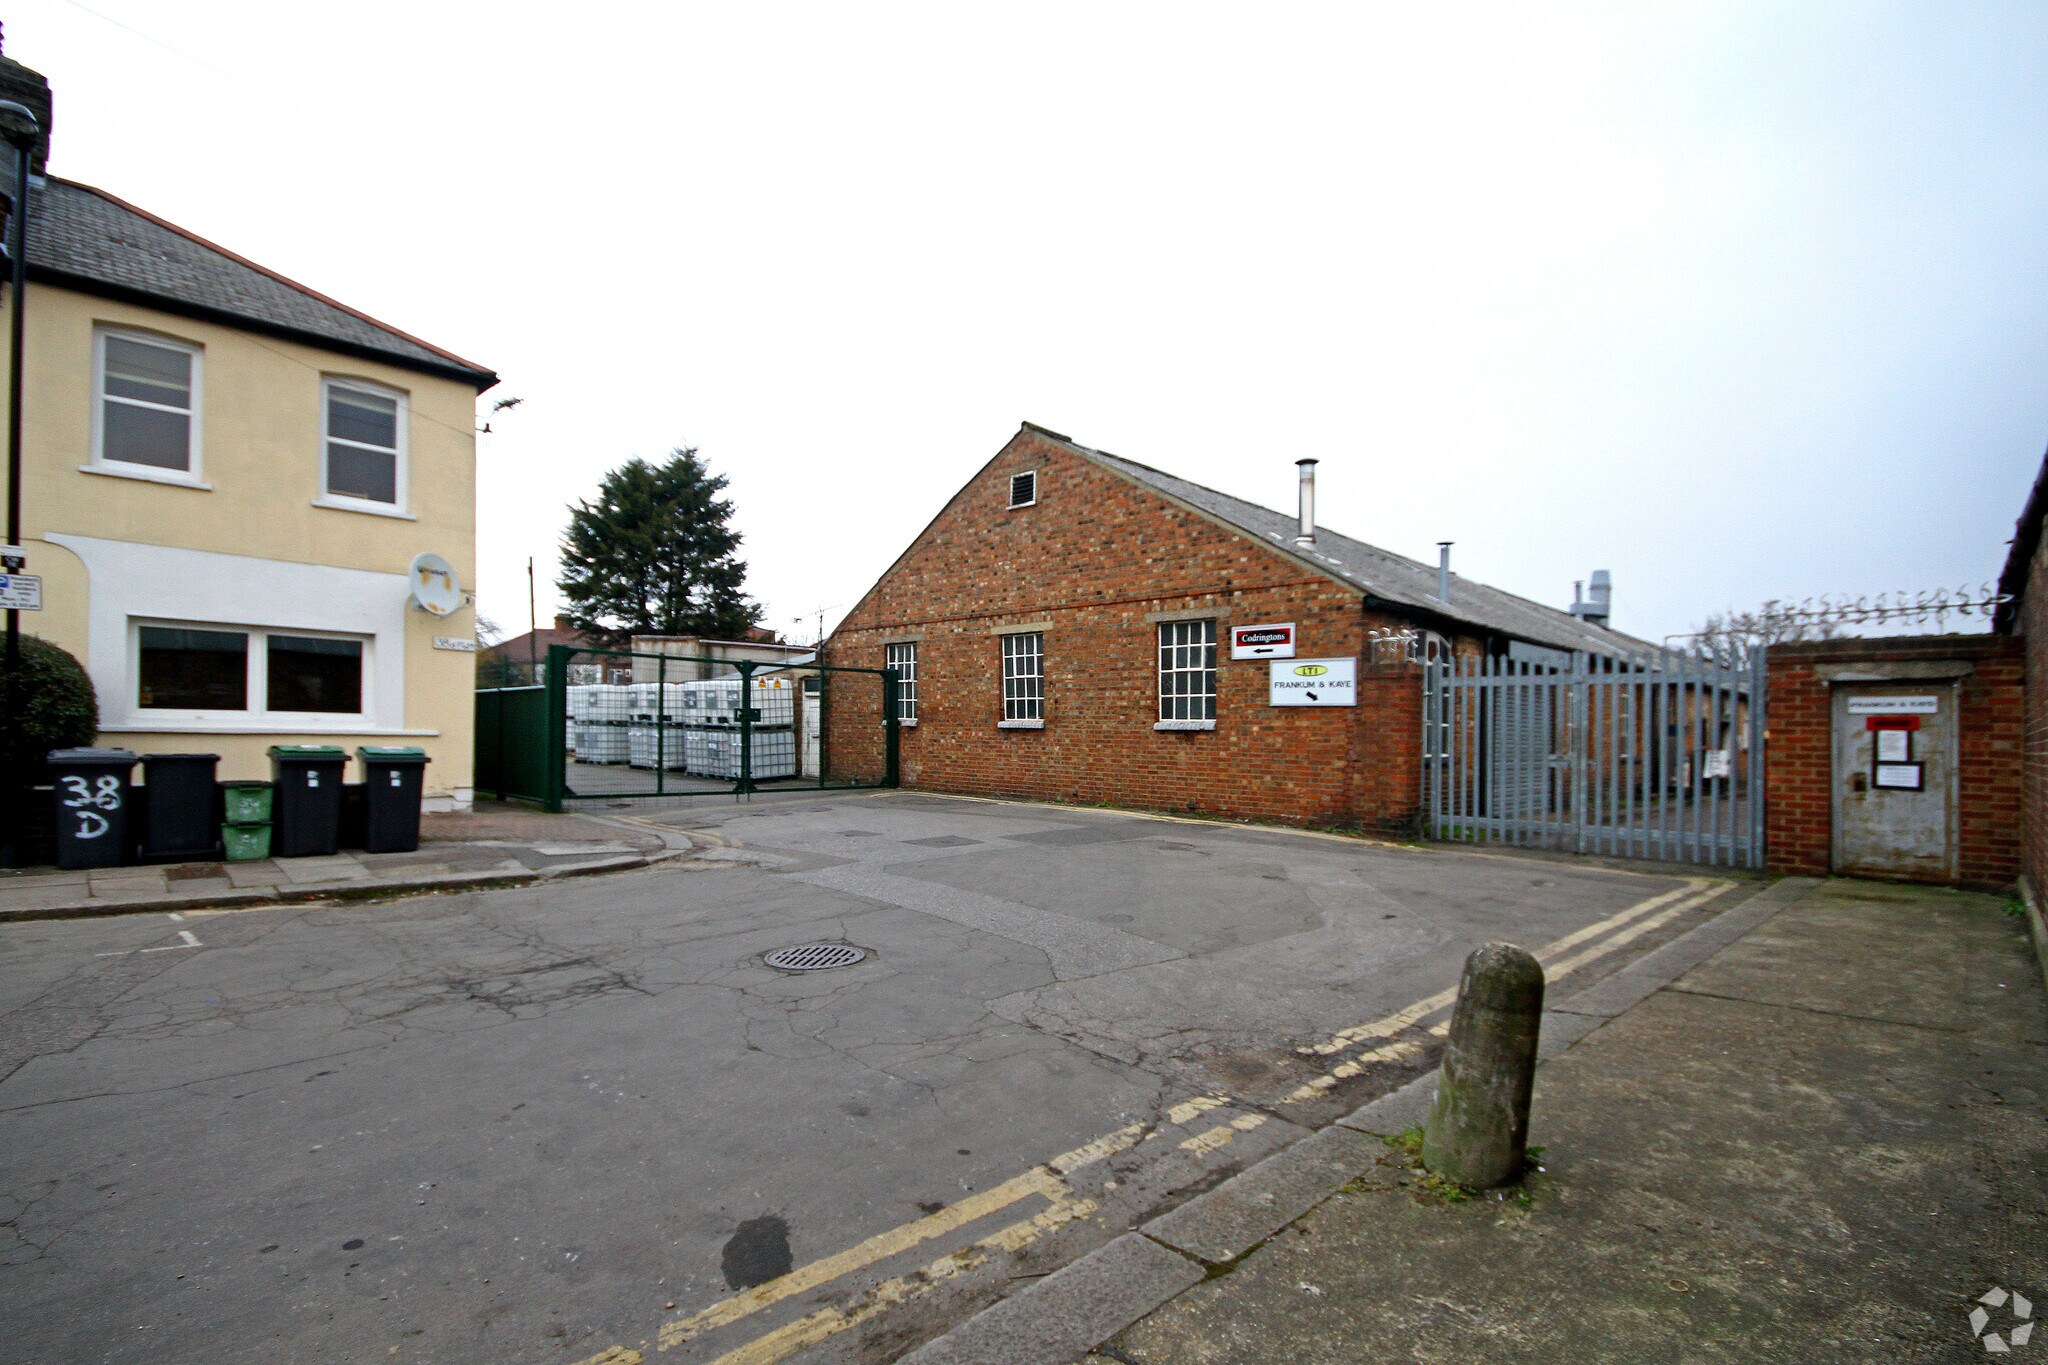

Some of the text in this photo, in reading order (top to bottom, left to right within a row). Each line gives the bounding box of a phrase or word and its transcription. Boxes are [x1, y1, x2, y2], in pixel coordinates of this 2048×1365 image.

[1241, 633, 1286, 643] Codringtons
[1302, 667, 1318, 675] LTI
[1329, 680, 1353, 688] KAYE
[61, 775, 121, 810] 38
[75, 811, 109, 838] D
